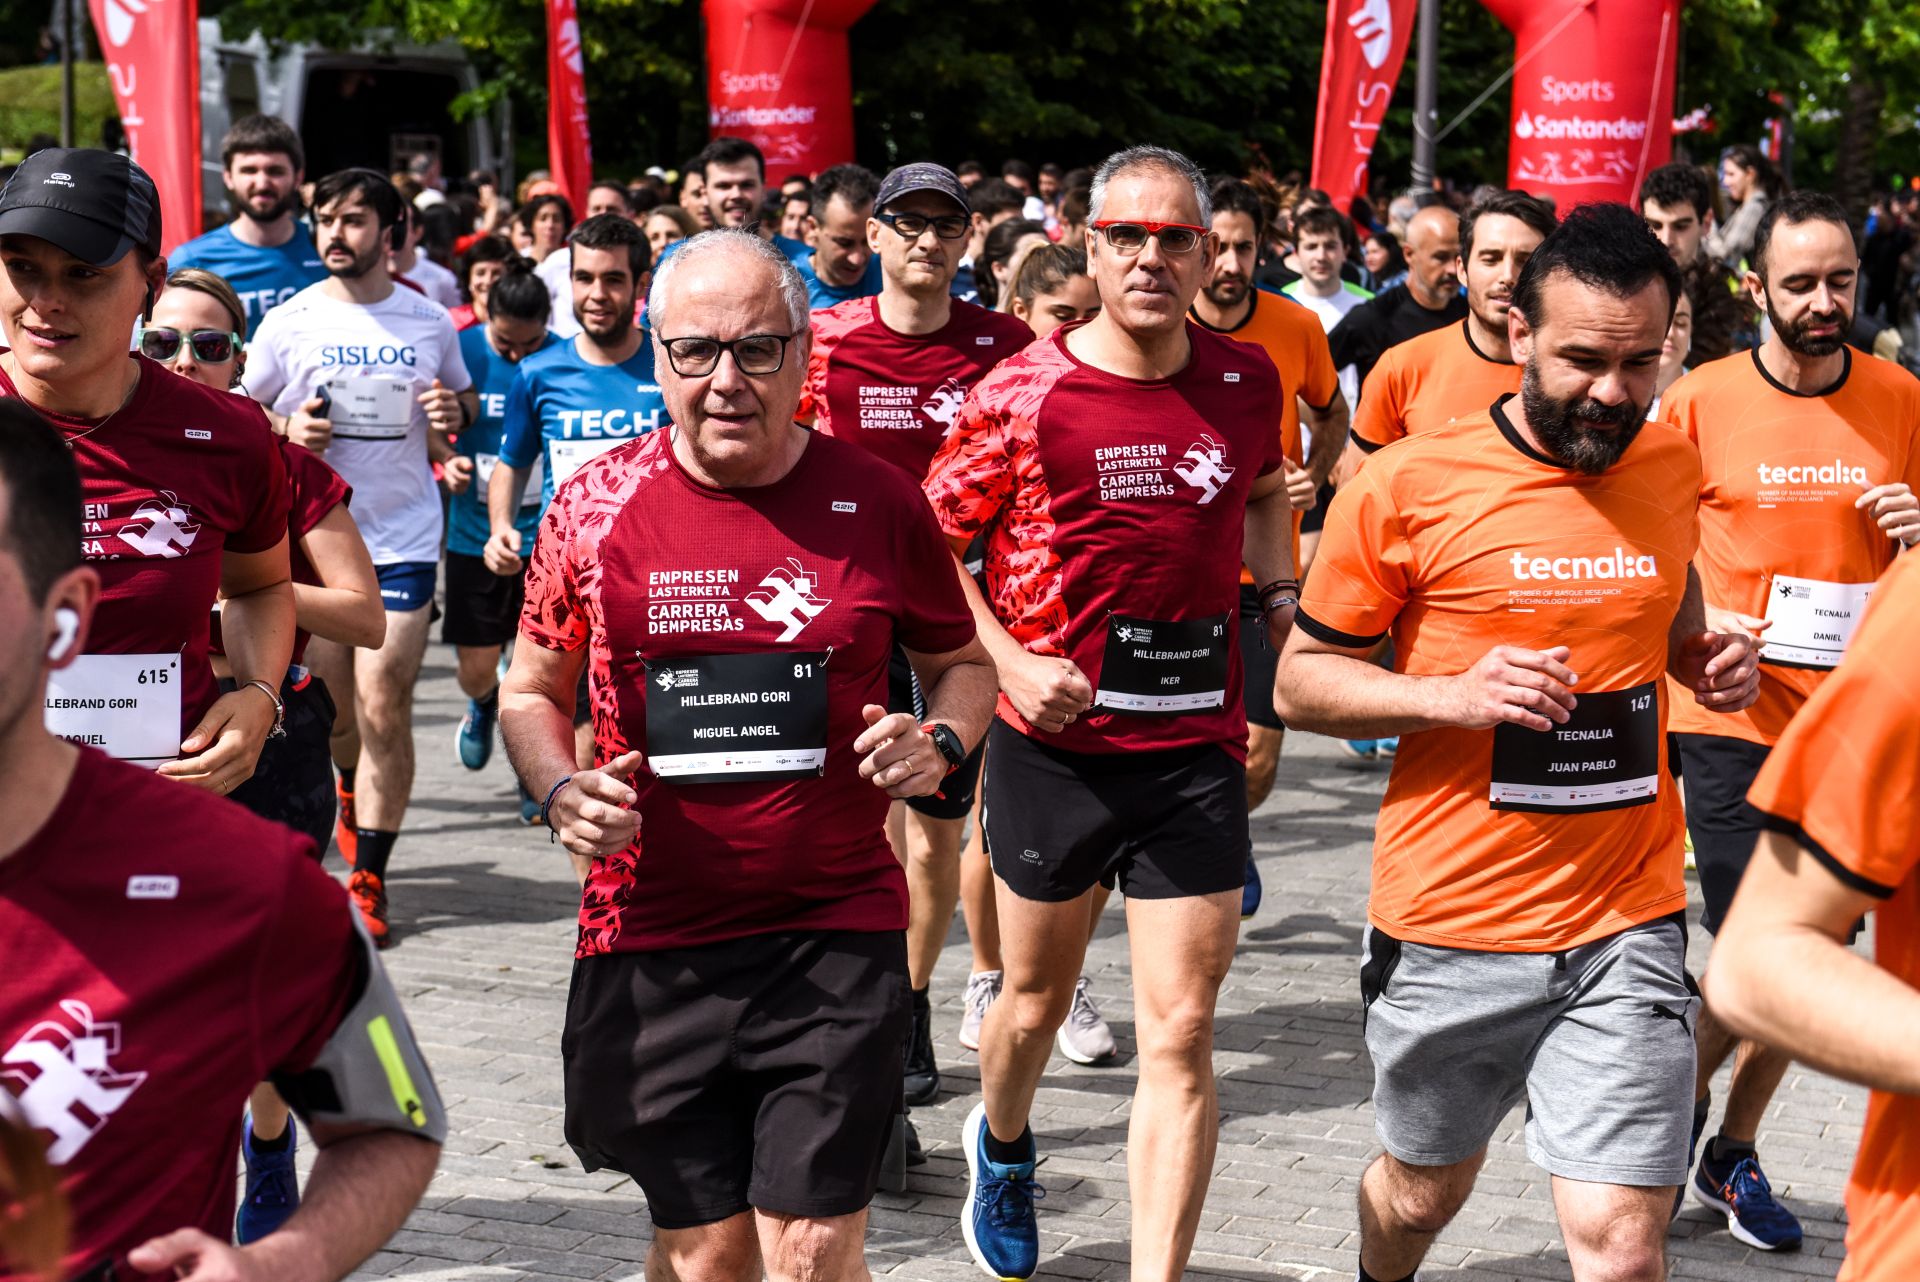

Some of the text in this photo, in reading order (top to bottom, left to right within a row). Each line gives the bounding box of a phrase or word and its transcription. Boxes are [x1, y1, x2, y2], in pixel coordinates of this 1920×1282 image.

[1541, 75, 1614, 105] Sports
[1534, 114, 1646, 139] Santander
[321, 345, 417, 366] SISLOG
[859, 386, 918, 397] ENPRESEN
[859, 397, 912, 405] LASTERKETA
[860, 409, 913, 420] CARRERA
[557, 409, 660, 438] TECH
[861, 420, 923, 429] DEMPRESAS
[1095, 444, 1167, 461] ENPRESEN
[1097, 457, 1162, 472] LASTERKETA
[1099, 472, 1163, 489] CARRERA
[1100, 484, 1175, 501] DEMPRESAS
[649, 569, 739, 585] ENPRESEN
[648, 586, 730, 598] LASTERKETA
[1508, 589, 1541, 597] MEMBER
[1555, 589, 1584, 597] BASQUE
[1585, 588, 1621, 596] RESEARCH
[647, 603, 730, 620] CARRERA
[1815, 608, 1851, 619] TECNALIA
[648, 617, 745, 635] DEMPRESAS
[1213, 625, 1223, 636] 81
[1813, 632, 1842, 643] DANIEL
[1133, 648, 1210, 660] HILLEBRAND GORI
[138, 669, 168, 684] 615
[793, 664, 812, 679] 81
[1160, 676, 1180, 685] IKER
[46, 698, 137, 709] LEBRAND GORI
[681, 692, 790, 707] HILLEBRAND GORI
[1631, 695, 1651, 712] 147
[693, 726, 780, 739] MIGUEL ANGEL
[1556, 729, 1613, 741] TECNALIA
[1547, 759, 1616, 772] JUAN PABLO
